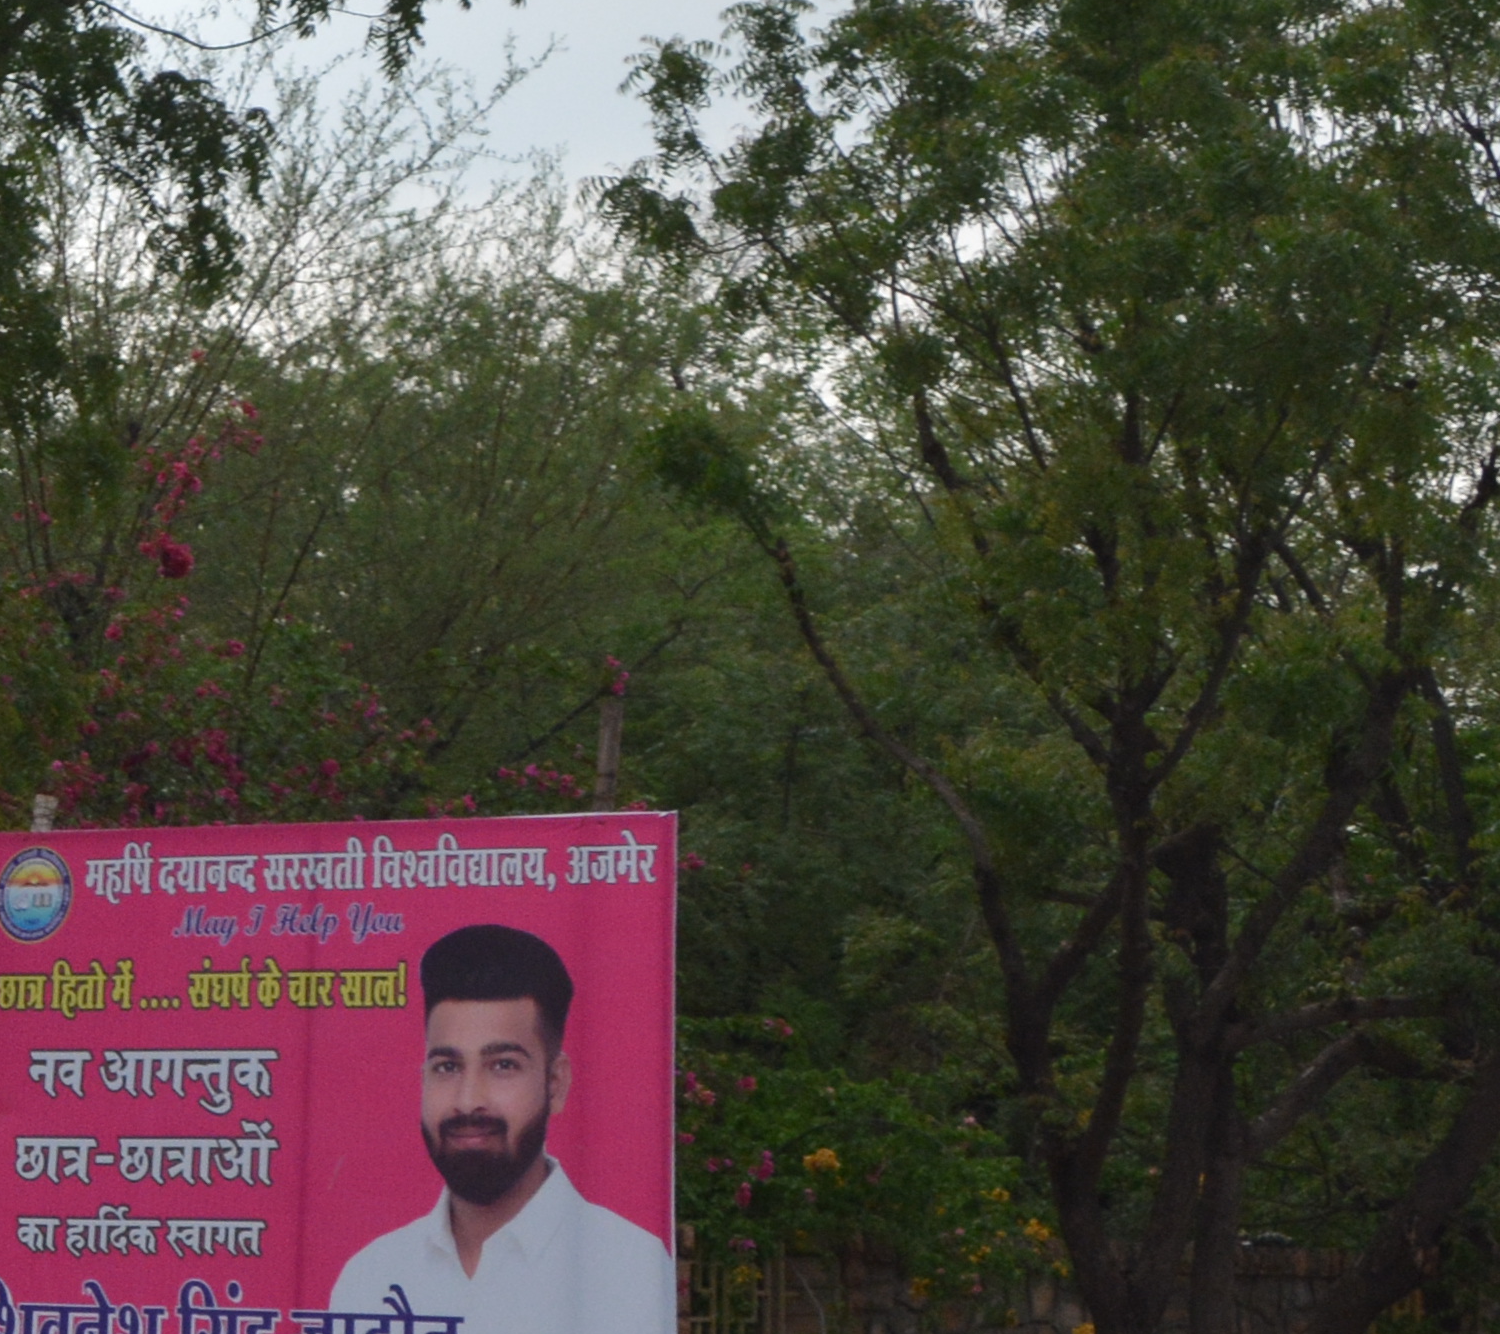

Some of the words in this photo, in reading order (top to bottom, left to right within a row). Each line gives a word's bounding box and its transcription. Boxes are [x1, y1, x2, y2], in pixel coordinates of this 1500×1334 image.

[85, 841, 154, 904] महर्षि
[158, 853, 259, 896] दयानन्द
[263, 836, 367, 892] सरस्वती
[565, 829, 658, 886] अजमेर
[173, 904, 239, 946] May
[244, 903, 267, 936] I
[270, 902, 339, 945] Help
[347, 902, 405, 944] You
[111, 957, 135, 1010] में
[187, 956, 253, 1009] संघर्ष
[256, 957, 283, 1009] के
[286, 970, 337, 1008] चार
[339, 960, 407, 1009] साल!
[28, 1049, 94, 1099] नव
[99, 1048, 280, 1115] आगन्तुक
[16, 1216, 61, 1253] का
[64, 1203, 162, 1258] हार्दिक
[165, 1218, 267, 1257] स्वागत
